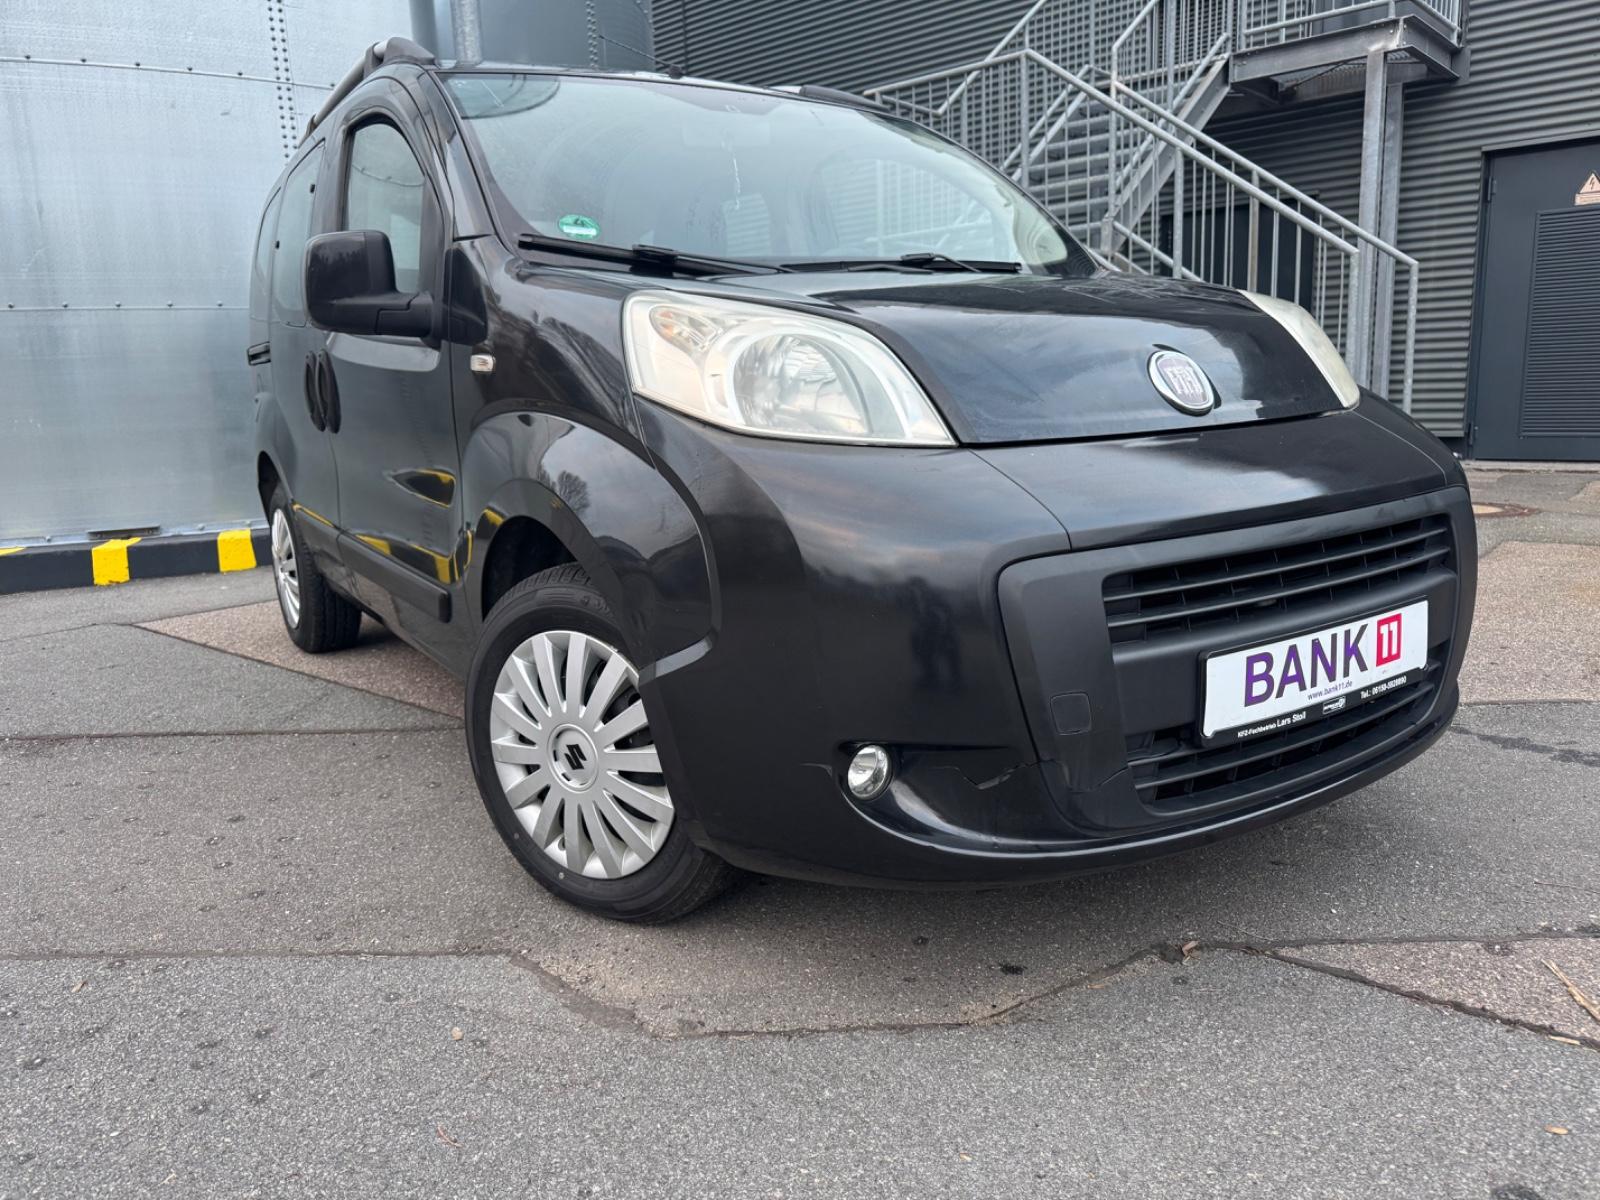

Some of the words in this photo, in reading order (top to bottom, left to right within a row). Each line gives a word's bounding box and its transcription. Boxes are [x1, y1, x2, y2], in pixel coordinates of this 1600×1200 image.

[1164, 366, 1204, 400] FIAT
[1244, 623, 1368, 707] BANK
[1380, 621, 1398, 659] 11
[1308, 680, 1353, 700] www.bank11.de
[1276, 717, 1291, 727] Lars
[1292, 710, 1307, 723] Stoll
